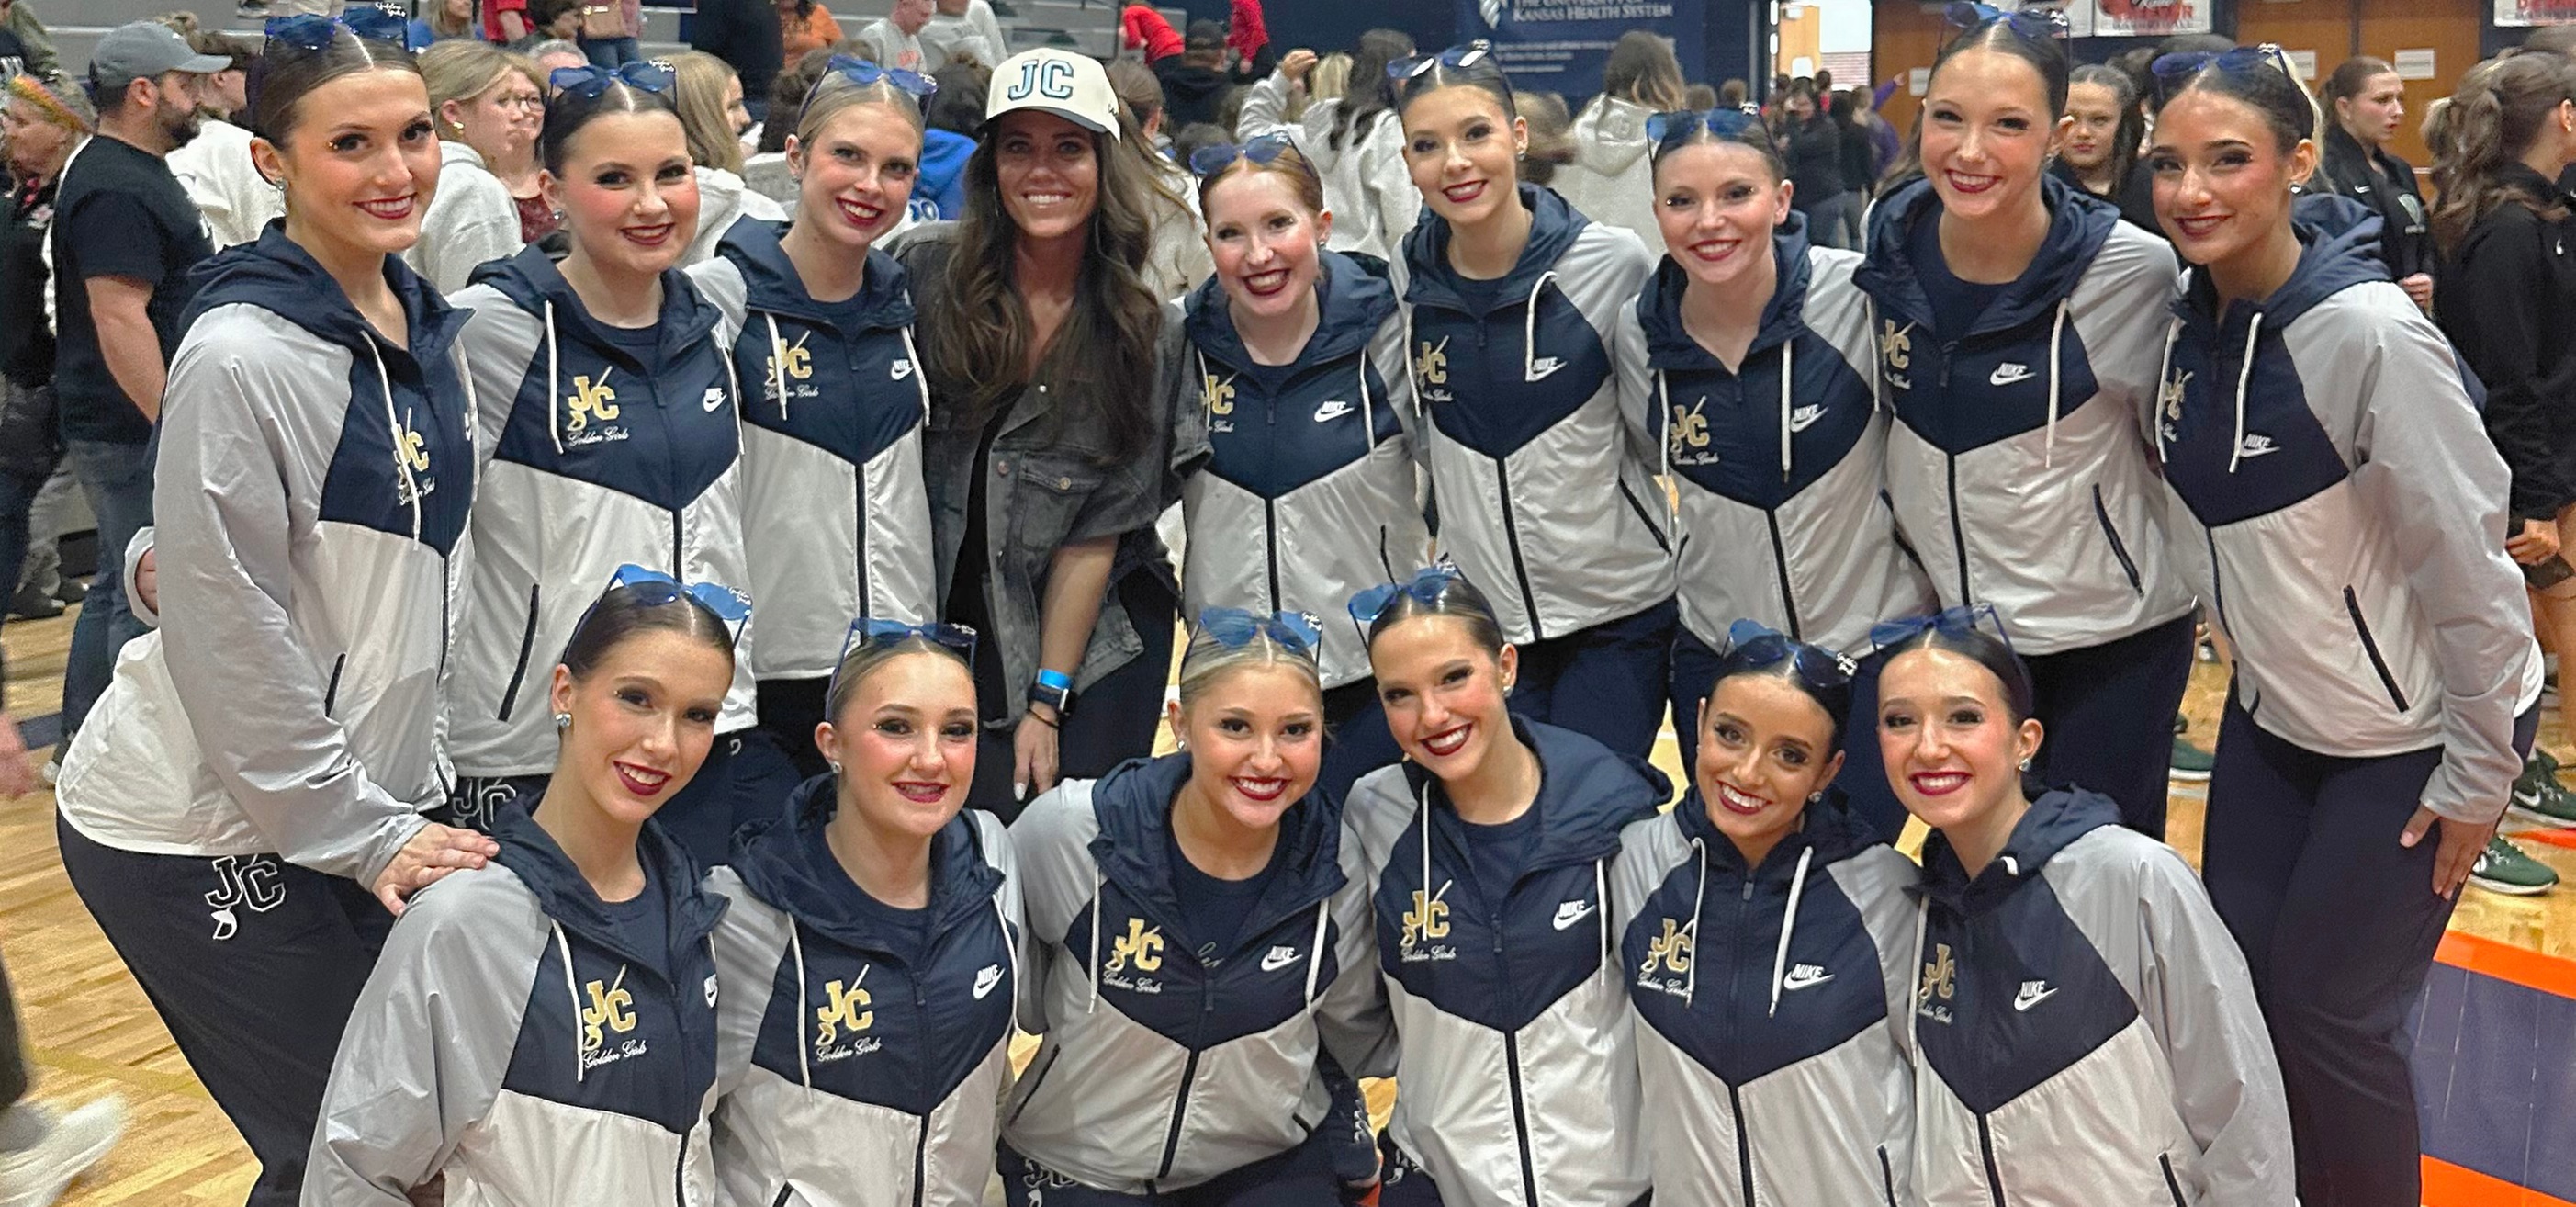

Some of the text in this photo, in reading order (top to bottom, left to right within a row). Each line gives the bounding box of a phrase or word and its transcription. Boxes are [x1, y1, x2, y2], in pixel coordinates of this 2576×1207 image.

[1008, 59, 1074, 101] JC
[568, 376, 620, 420] JC
[1670, 404, 1710, 446] JC
[204, 855, 286, 912] JC
[1403, 890, 1450, 938] JC
[1115, 917, 1164, 971] JC
[1650, 918, 1692, 975] JC
[1925, 943, 1955, 999] JC
[582, 980, 636, 1032] JC
[817, 980, 873, 1031] JC
[583, 1040, 647, 1069] Golden Girls
[855, 1036, 882, 1055] Girls
